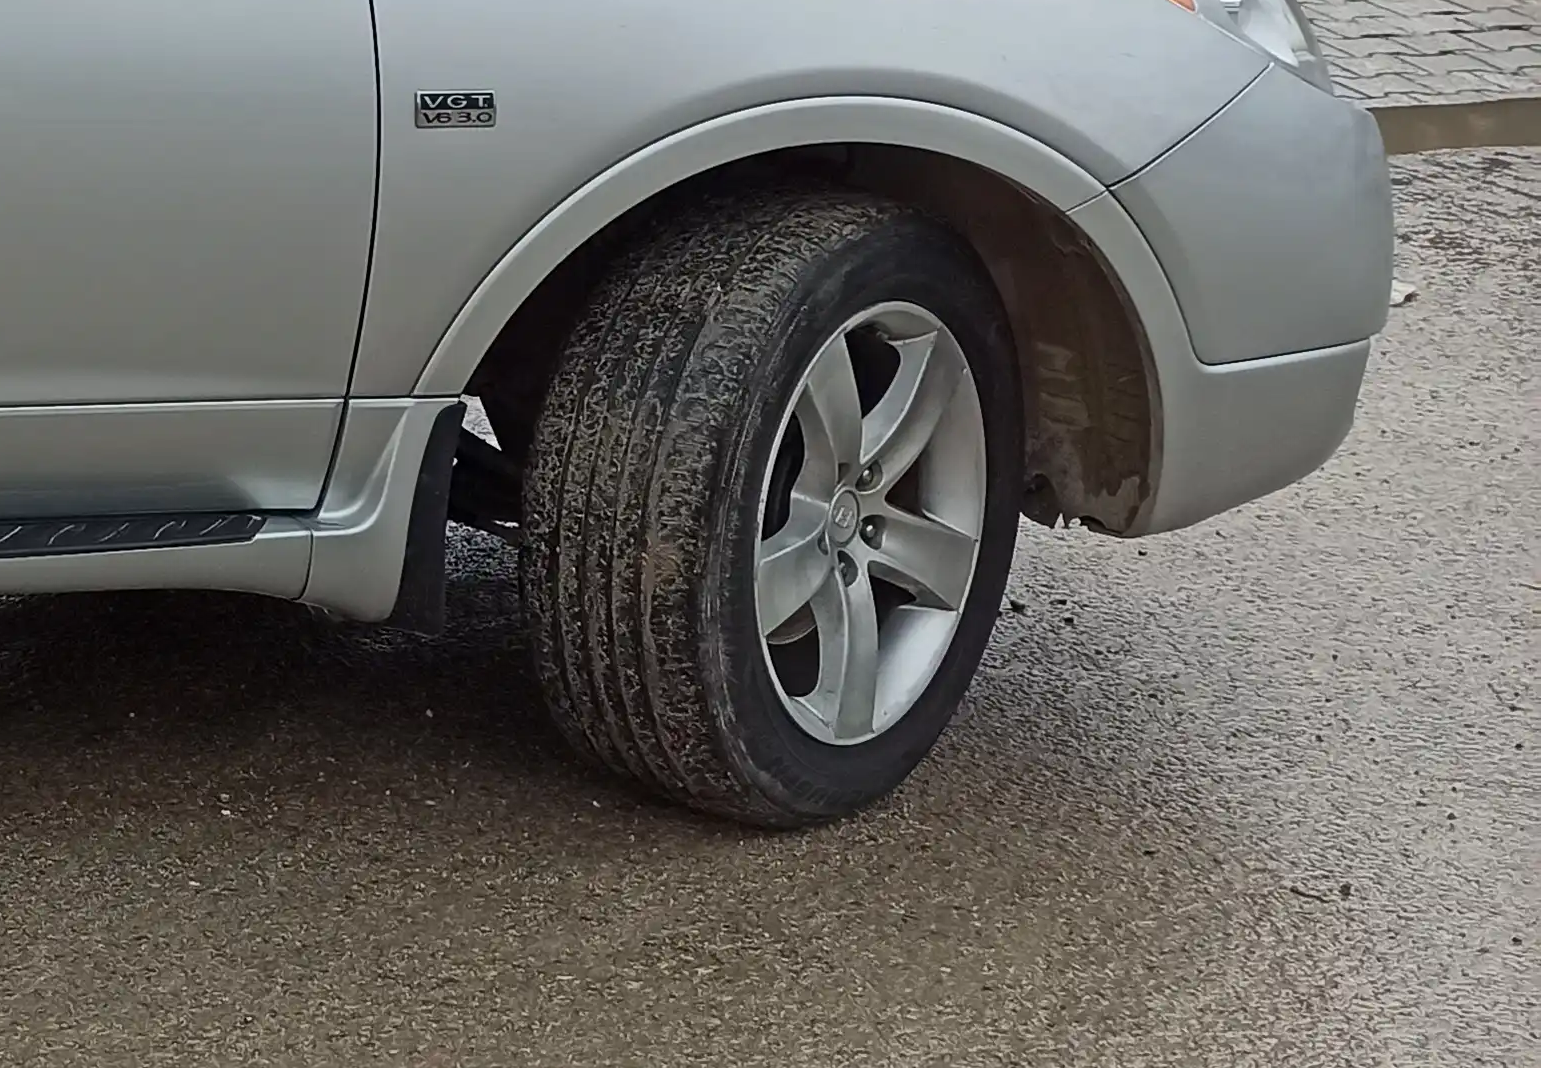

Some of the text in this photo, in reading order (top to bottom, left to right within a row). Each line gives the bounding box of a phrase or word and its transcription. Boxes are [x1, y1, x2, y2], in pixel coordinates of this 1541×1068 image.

[423, 95, 491, 108] VGT
[422, 112, 493, 124] V6 3.0
